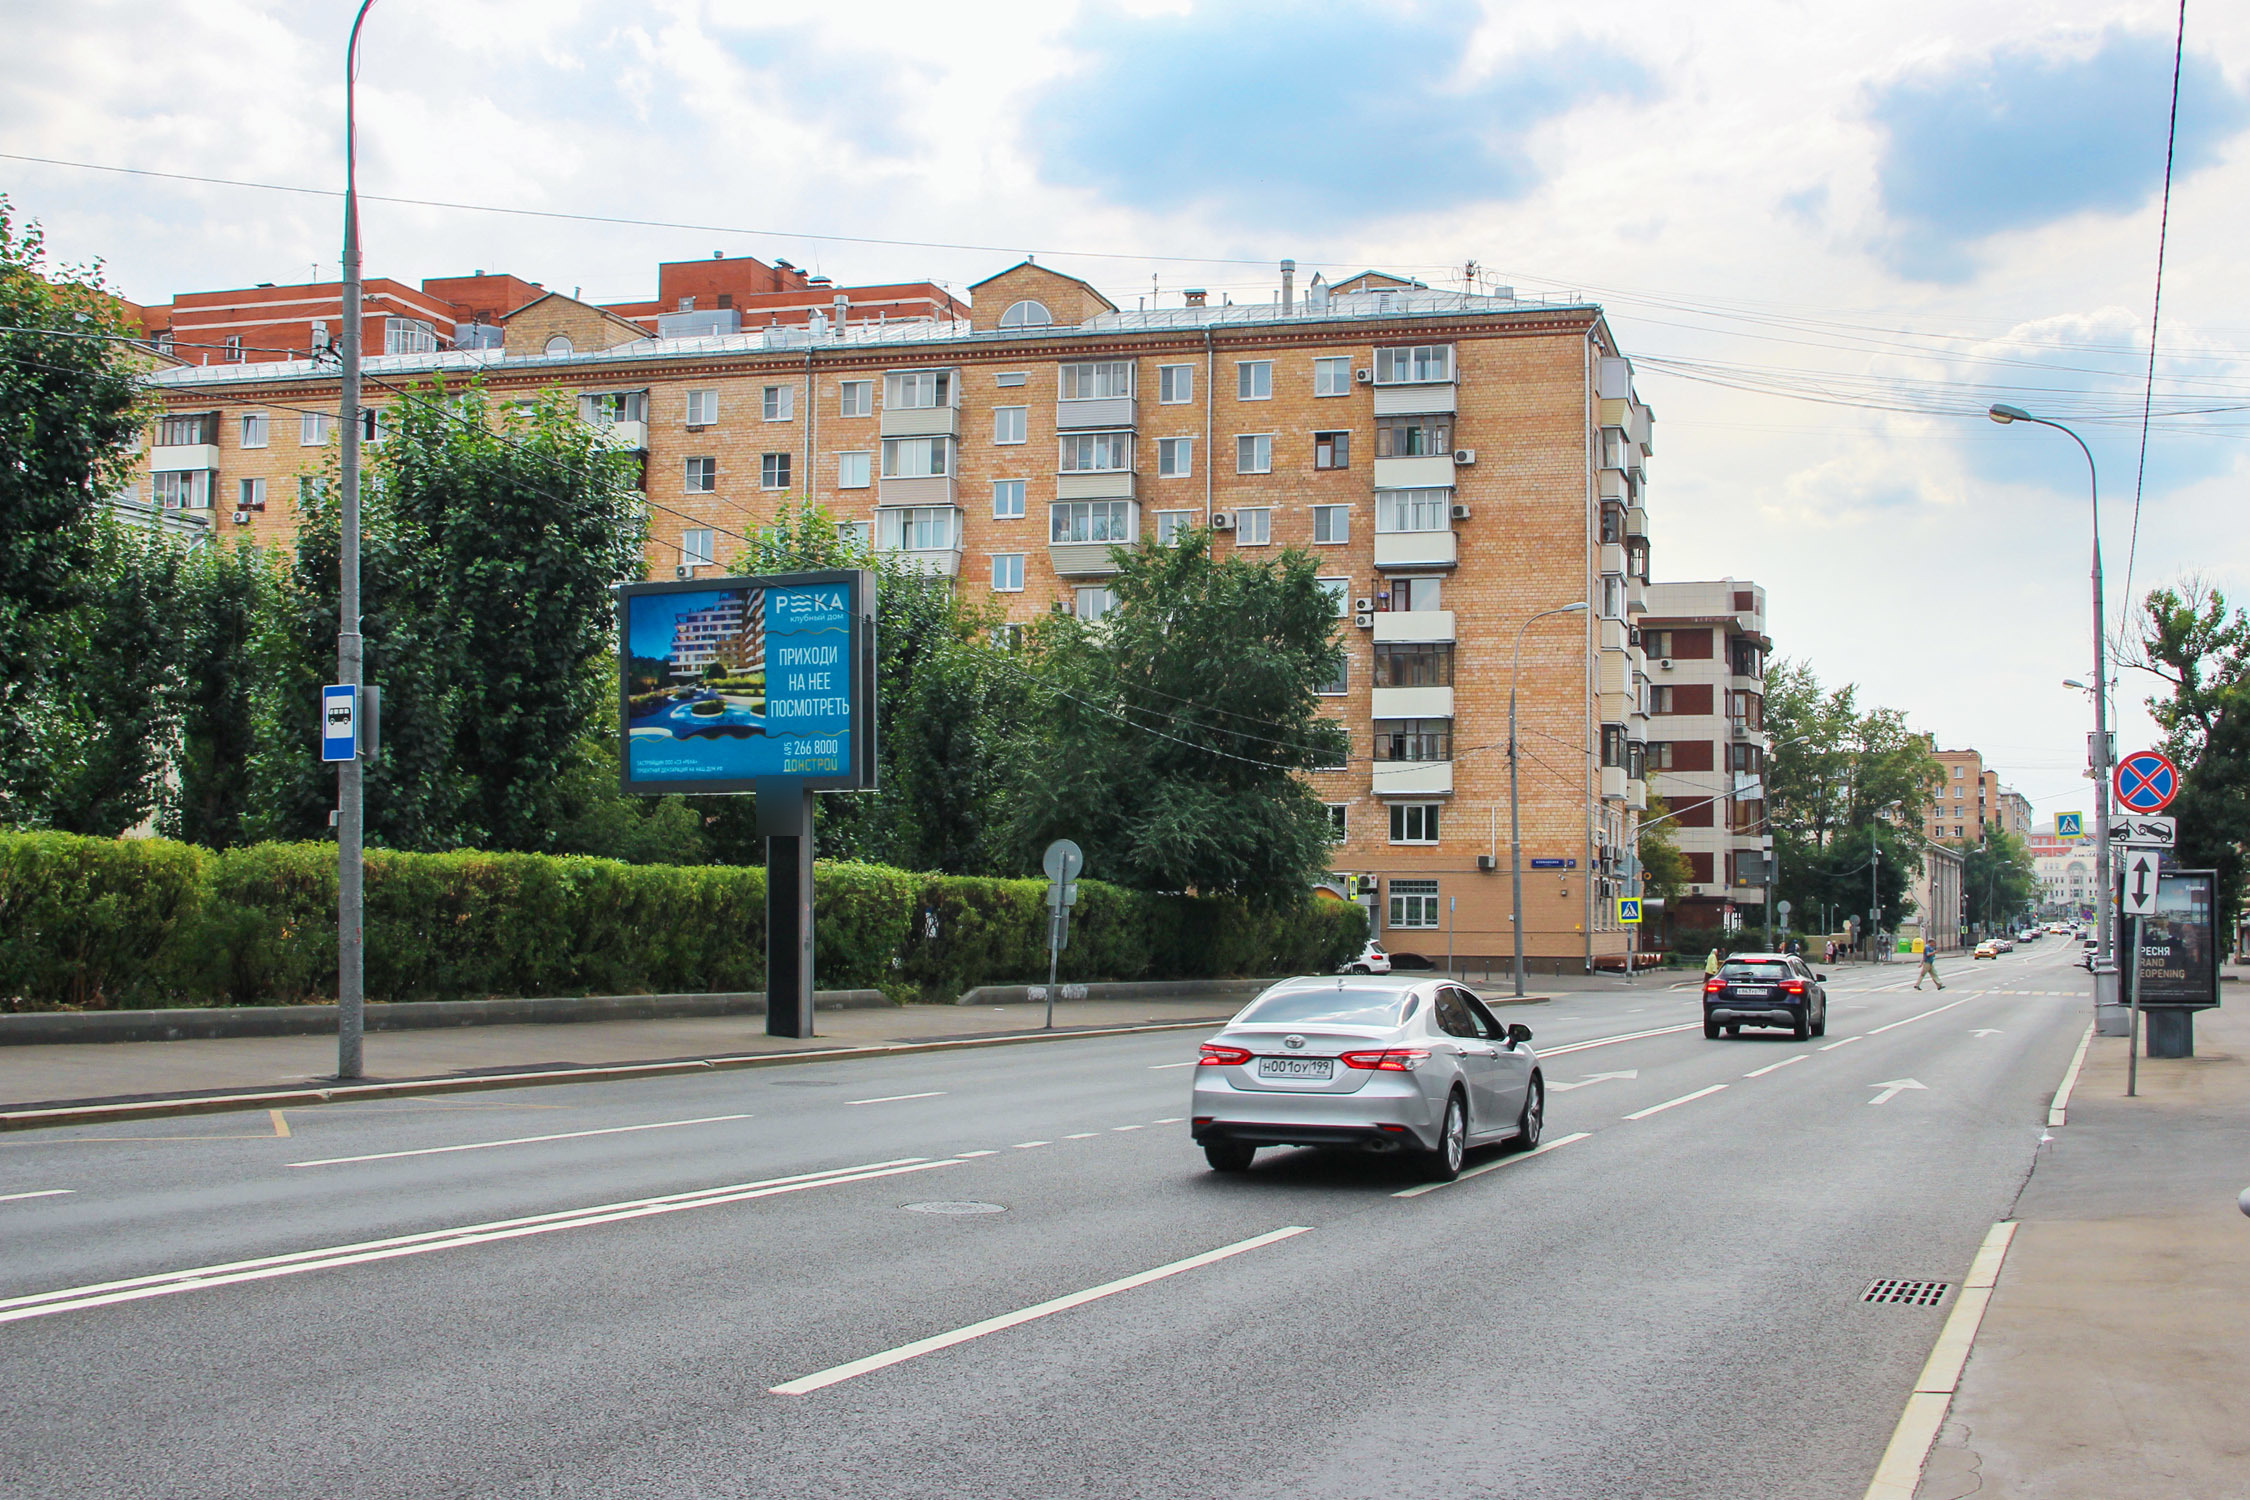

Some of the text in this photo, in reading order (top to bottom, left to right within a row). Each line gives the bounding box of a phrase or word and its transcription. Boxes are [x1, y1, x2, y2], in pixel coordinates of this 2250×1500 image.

[790, 612, 844, 624] клубный дом
[779, 645, 838, 666] ПРИХОДИ
[788, 672, 831, 691] НА НЕЕ
[770, 697, 850, 718] ПОСМОТРЕТЬ
[794, 740, 812, 755] 266
[814, 739, 838, 754] 8000
[783, 754, 838, 772] ДОНСТРОЙ
[2141, 946, 2171, 956] РЕСНЯ
[2140, 958, 2165, 967] RAND
[2140, 969, 2185, 979] EOPENING
[1311, 1061, 1329, 1071] 199
